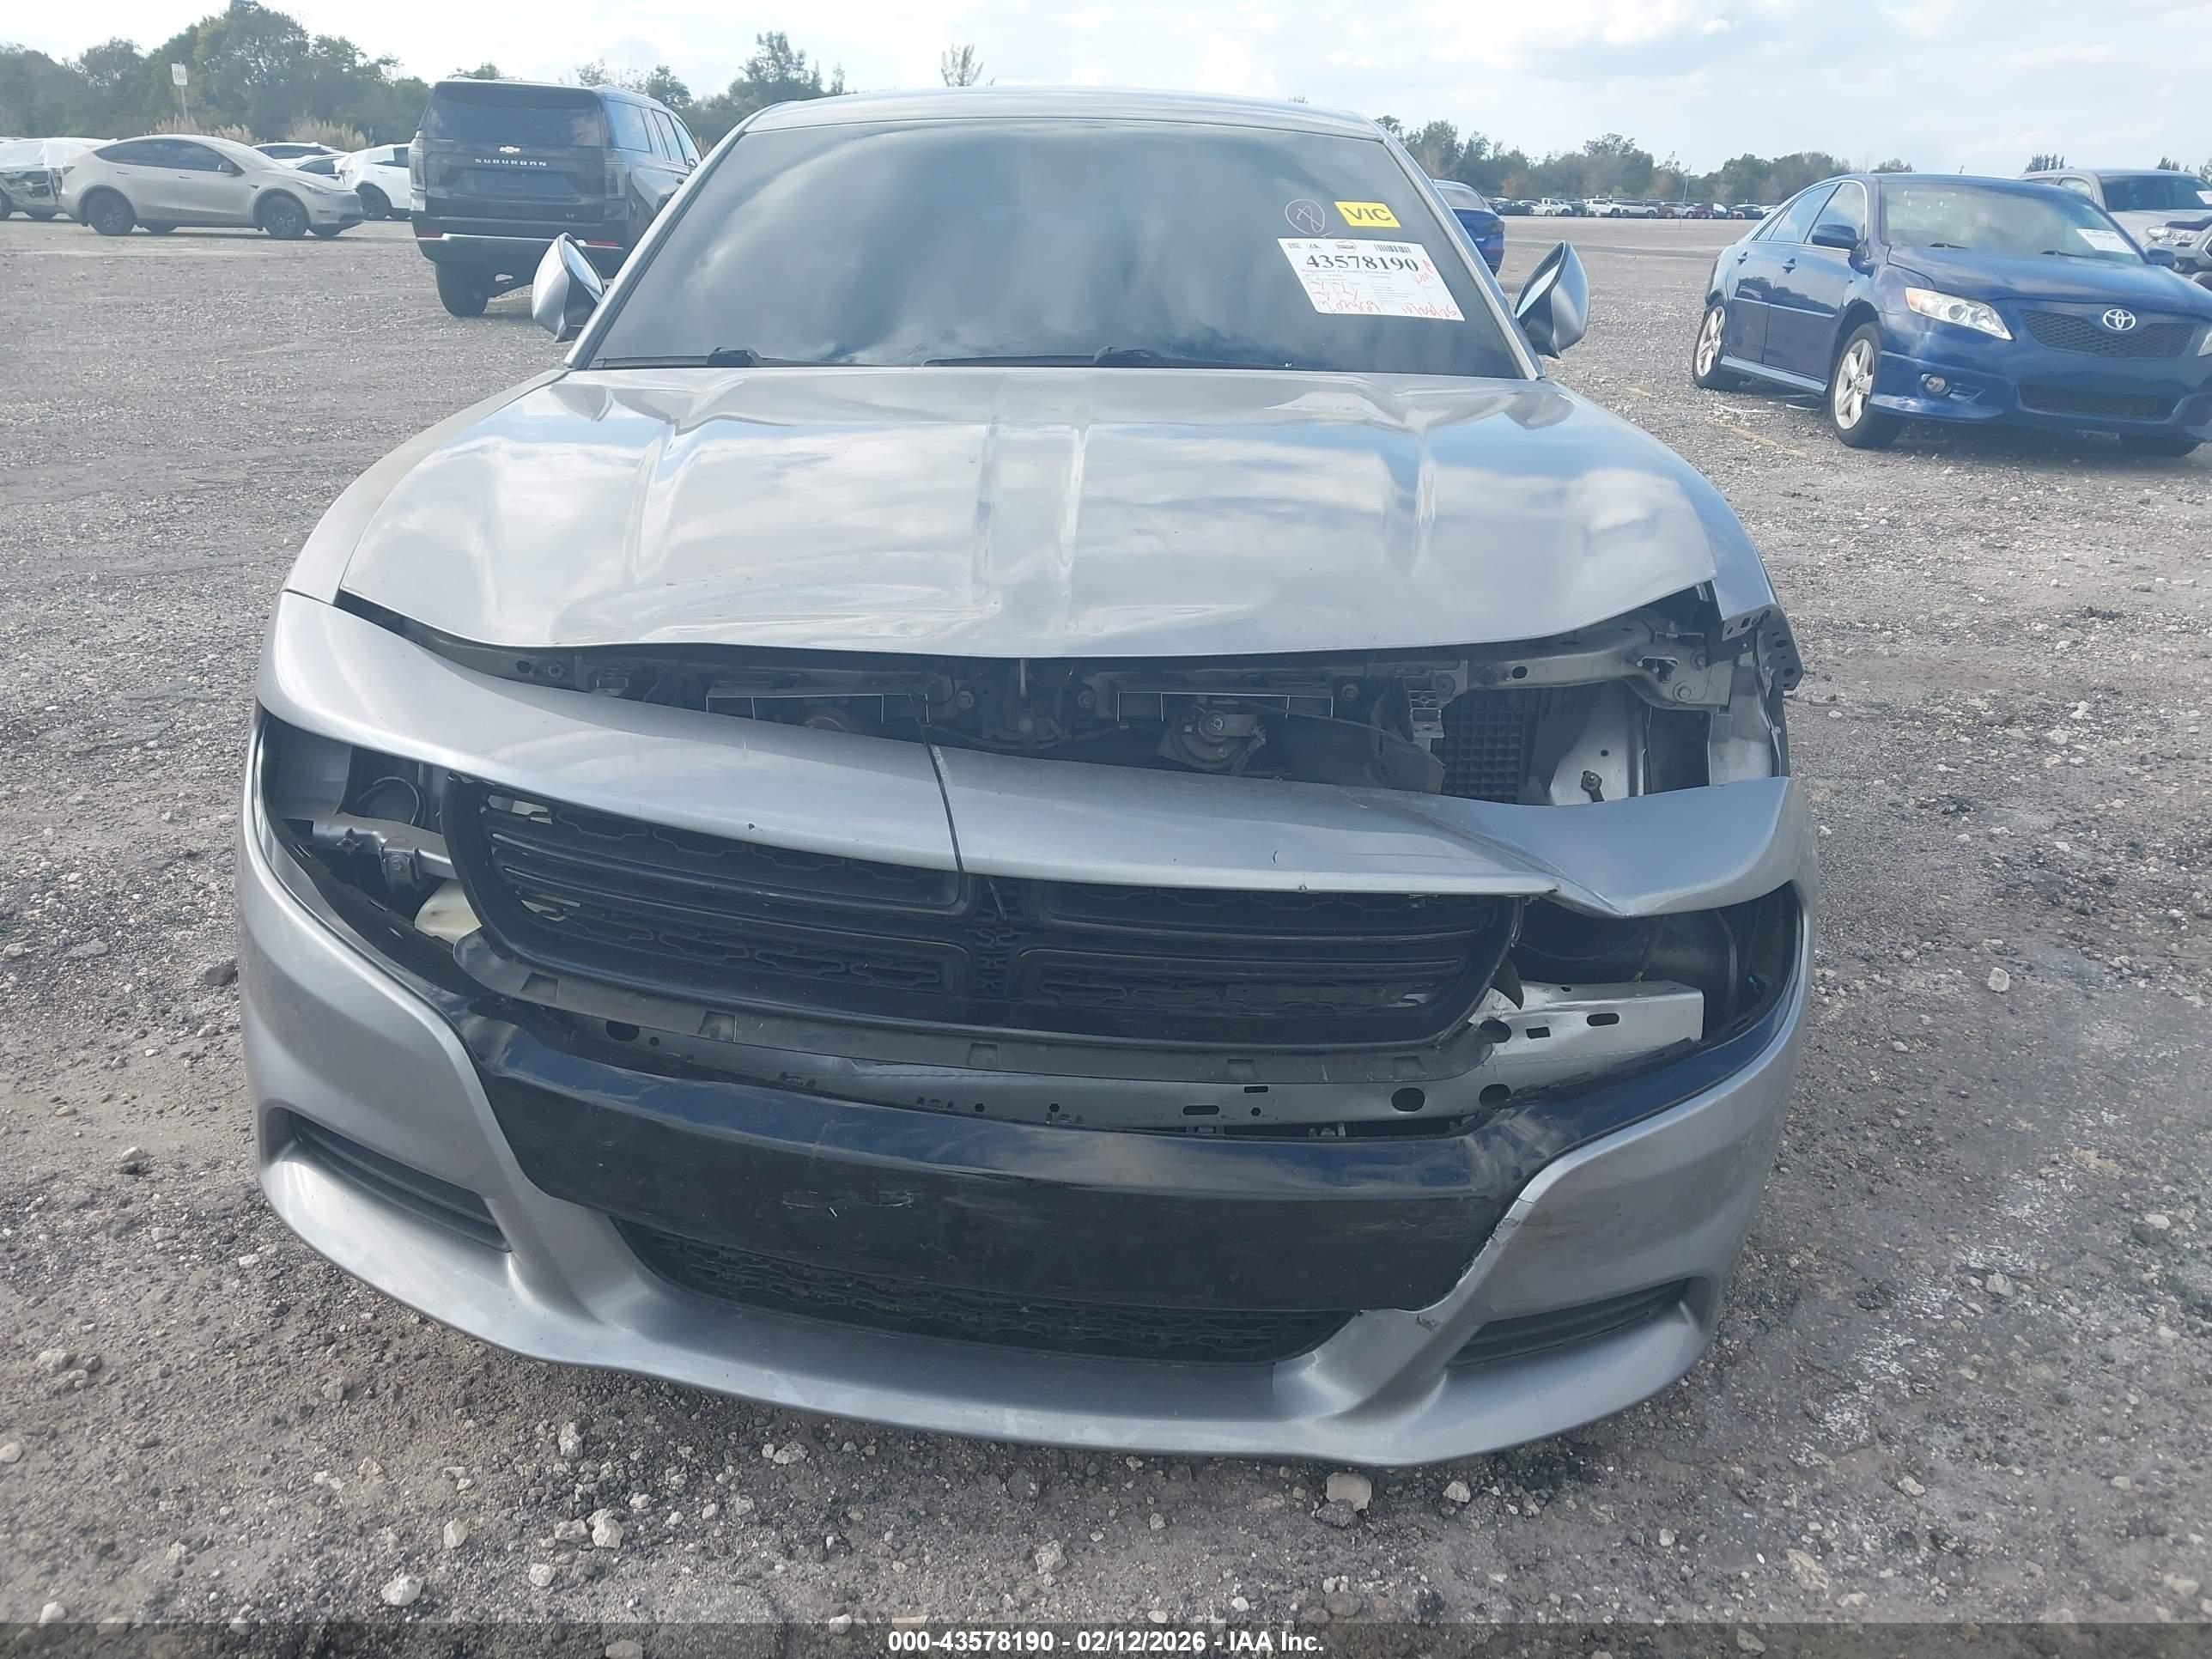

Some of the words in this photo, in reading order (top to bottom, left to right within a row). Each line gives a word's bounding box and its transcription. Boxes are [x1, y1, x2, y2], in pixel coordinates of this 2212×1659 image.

[475, 158, 547, 167] SUBURBAN
[1343, 207, 1391, 221] VIC
[1306, 255, 1419, 272] 43578190
